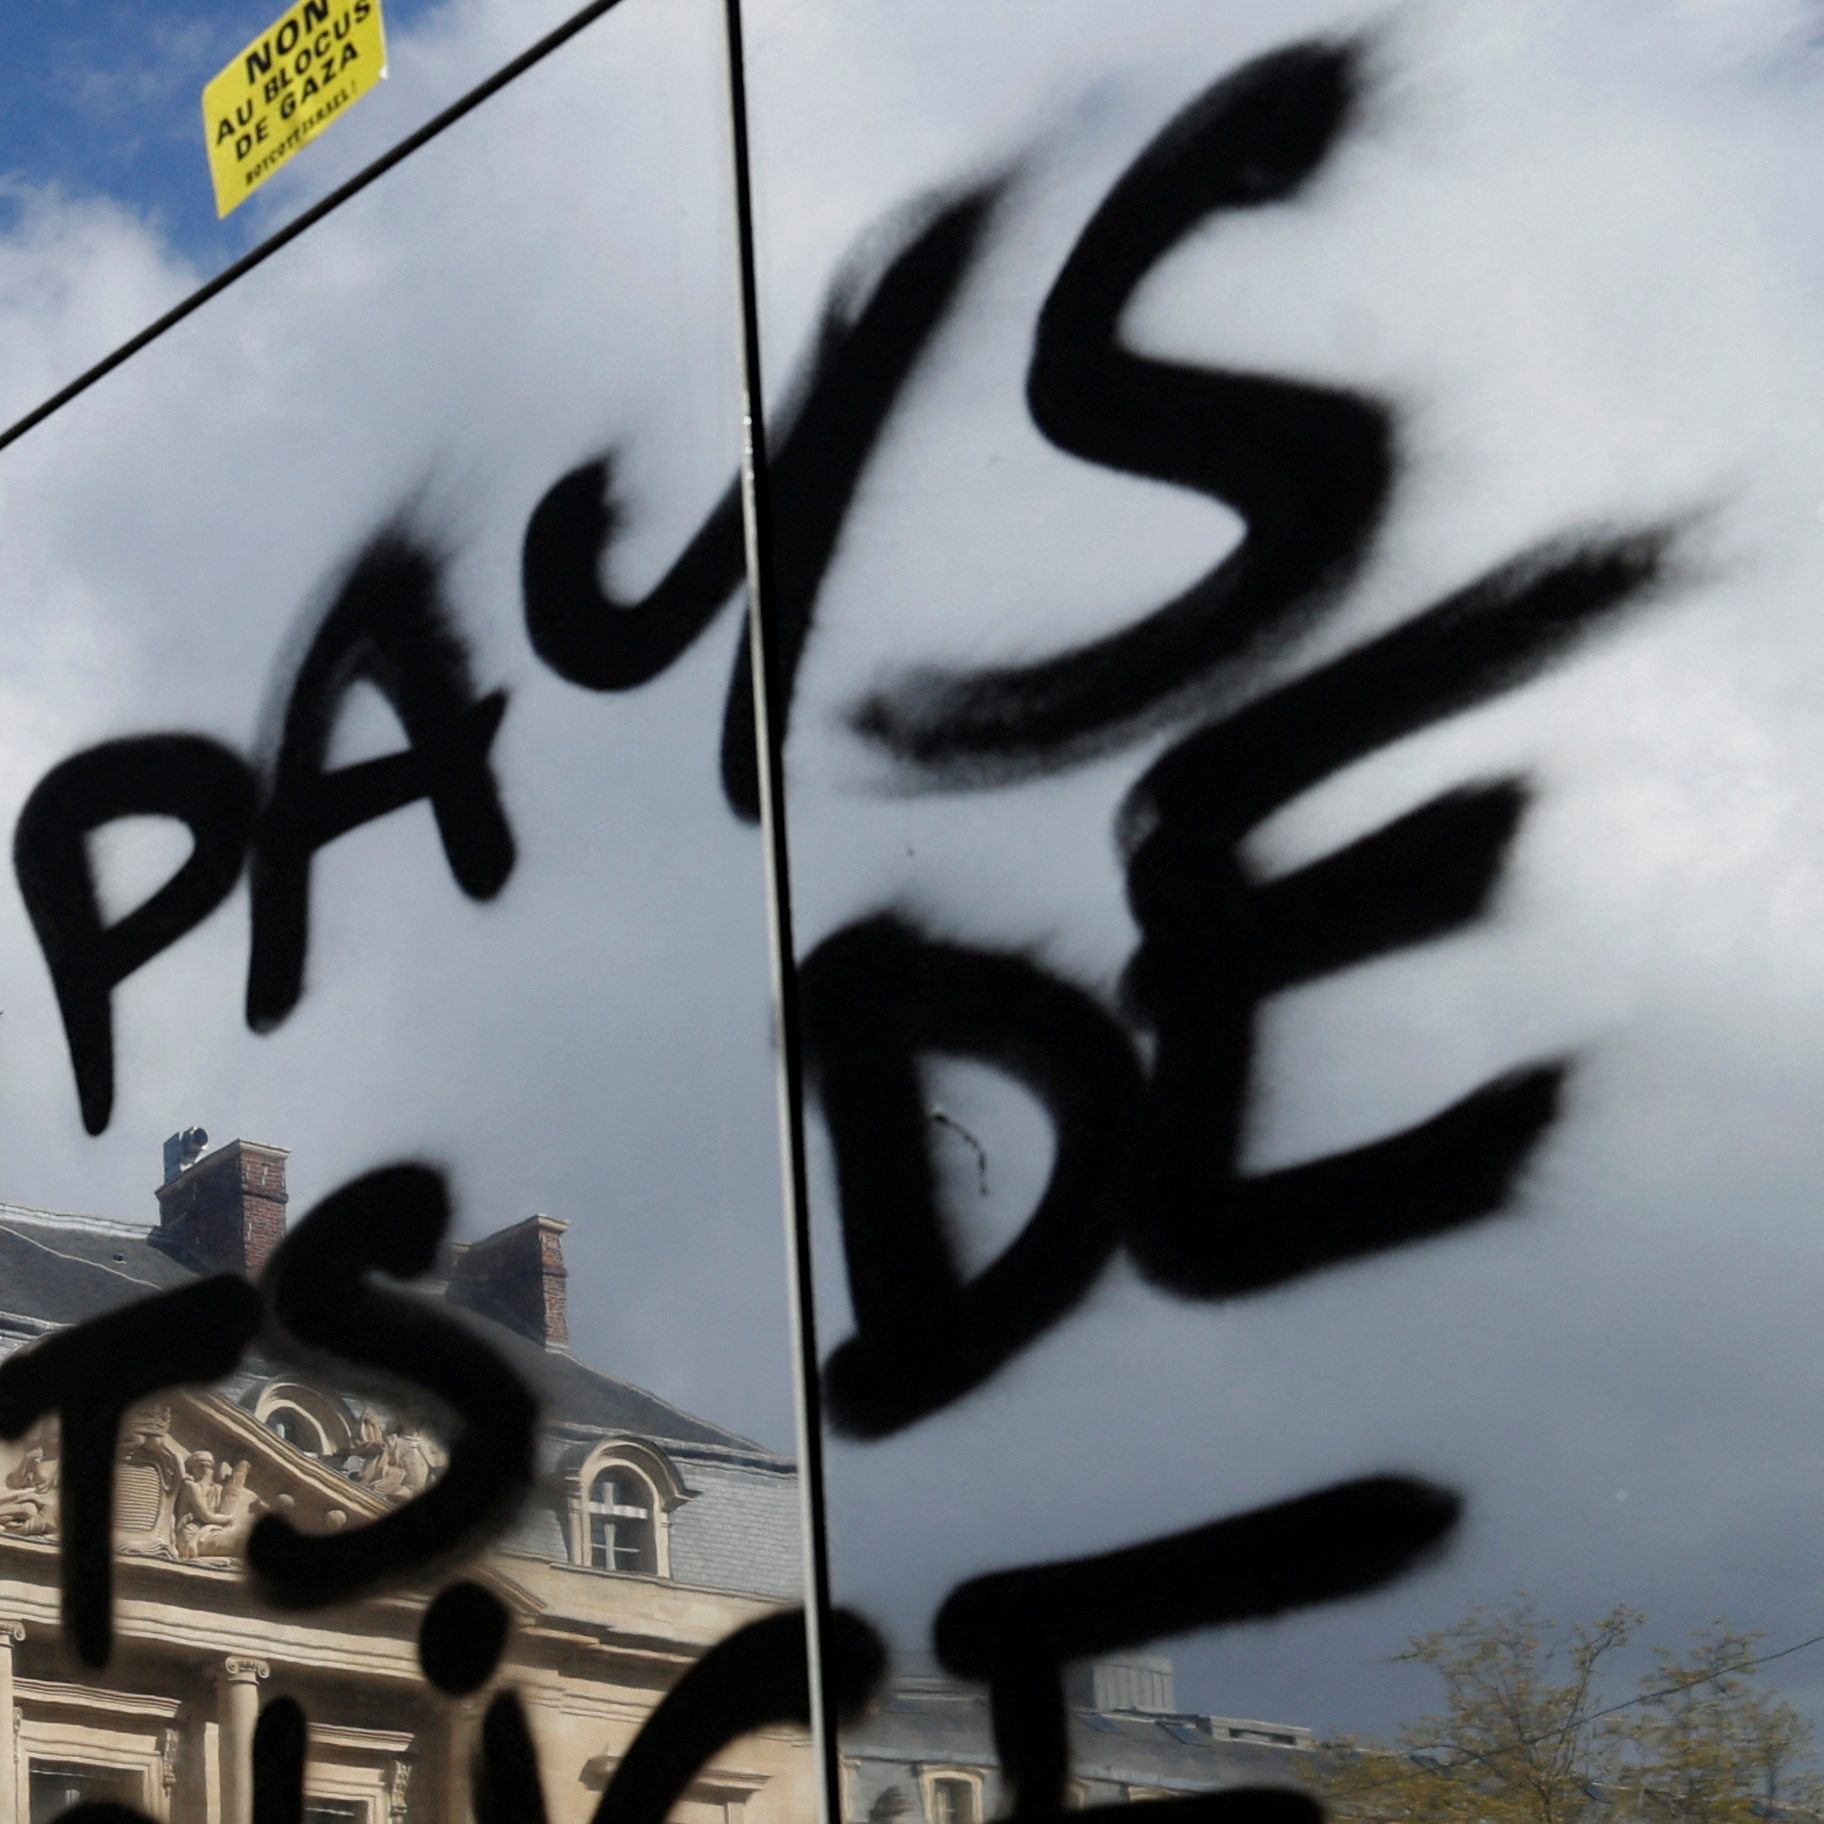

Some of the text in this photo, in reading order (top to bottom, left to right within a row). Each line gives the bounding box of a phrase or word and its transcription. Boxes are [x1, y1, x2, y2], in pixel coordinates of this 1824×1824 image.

[217, 1, 370, 146] AU BLOCUS
[235, 42, 358, 162] DE GAZA
[245, 0, 329, 84] NON
[12, 36, 1397, 1138] PAYS
[799, 520, 1692, 1442] DE
